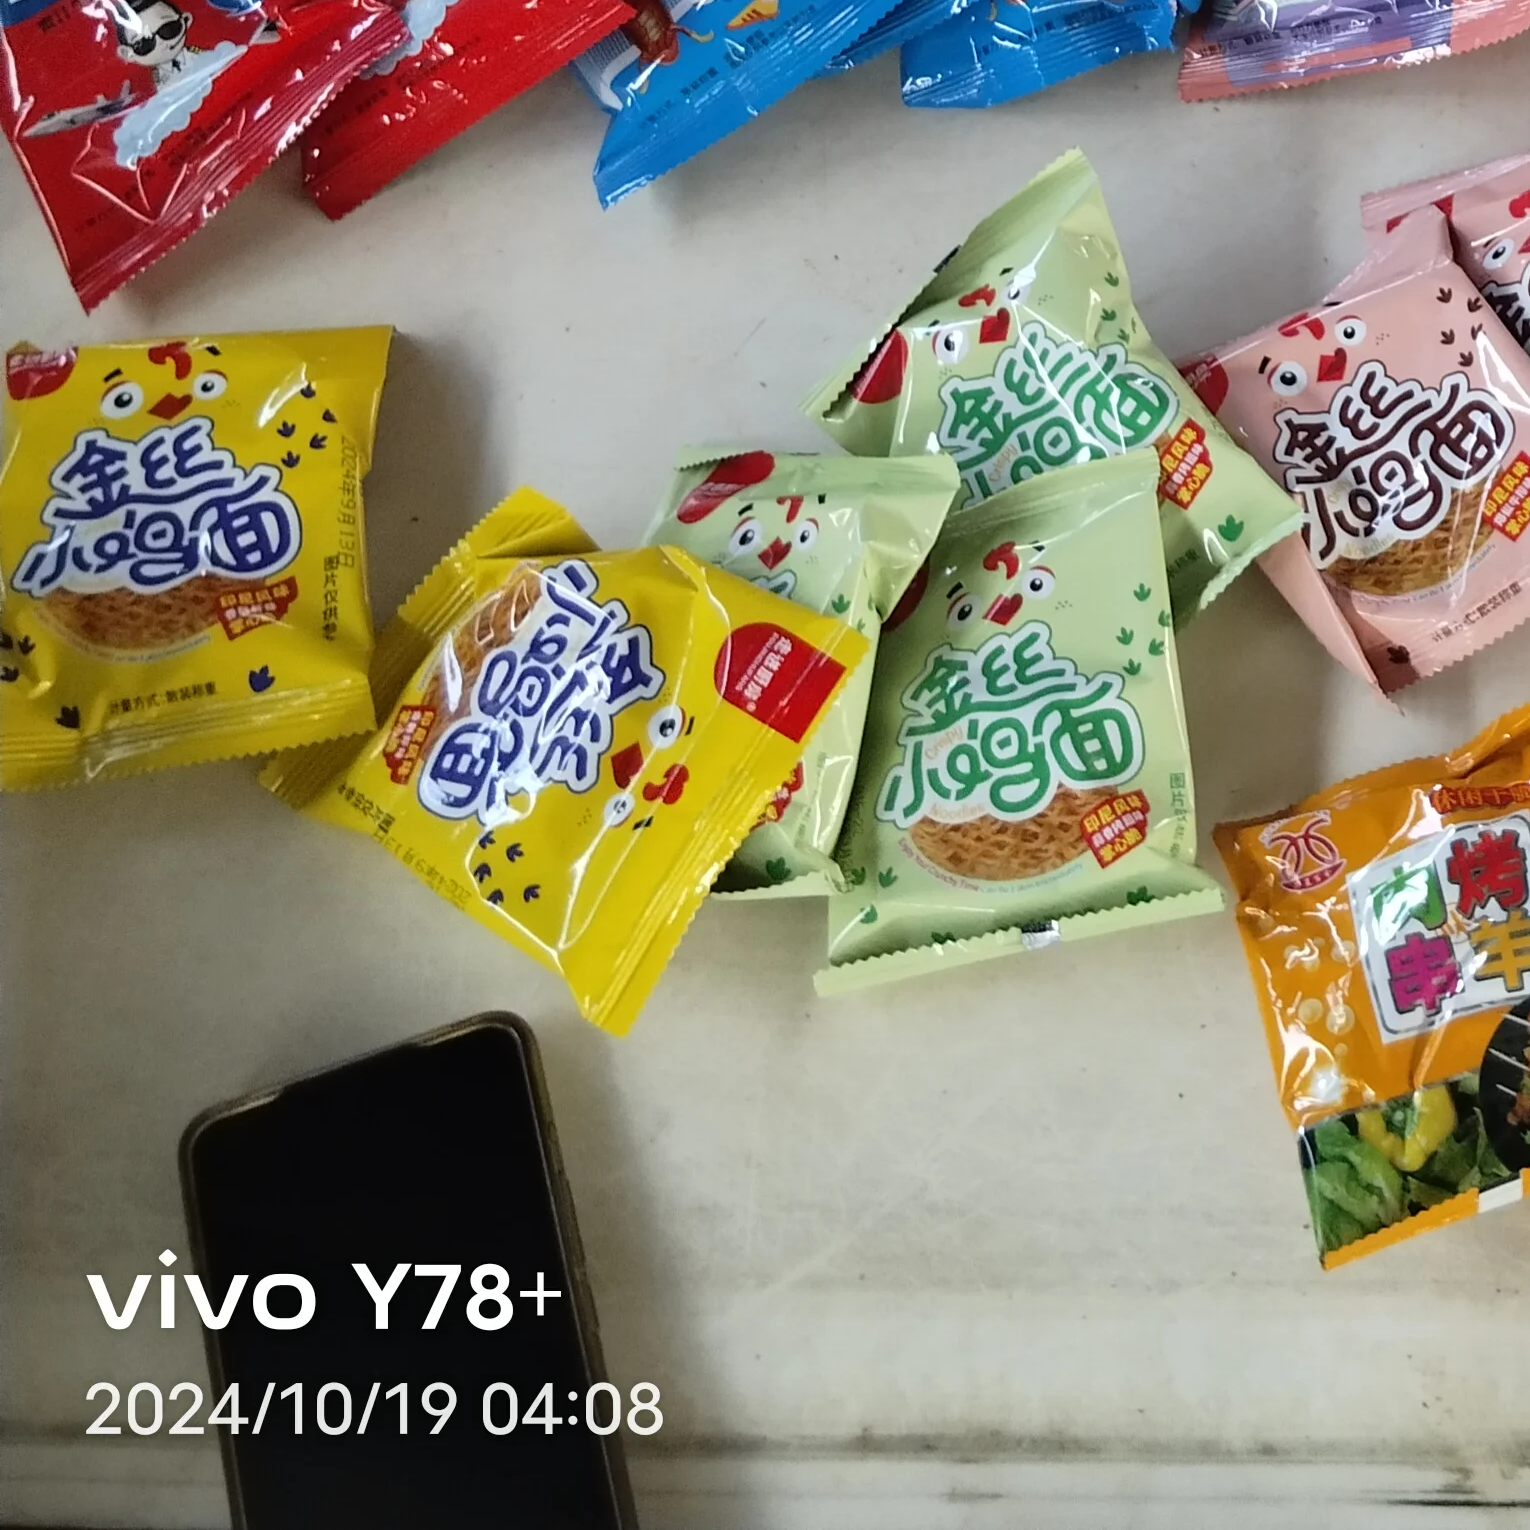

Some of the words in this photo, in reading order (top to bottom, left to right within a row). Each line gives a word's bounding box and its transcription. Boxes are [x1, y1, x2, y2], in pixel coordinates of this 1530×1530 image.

[1282, 370, 1432, 484] 金丝
[52, 424, 235, 520] 金丝
[338, 435, 358, 568] 2024年9月13日
[1175, 460, 1210, 504] 掌心脆
[1479, 457, 1530, 518] 印尼风味
[108, 680, 217, 716] 计量方式:散装称重
[742, 631, 794, 701] 走进厨房
[907, 630, 1077, 737] 金丝
[1082, 791, 1143, 833] 印尼风味
[1097, 825, 1143, 864] 掌心脆
